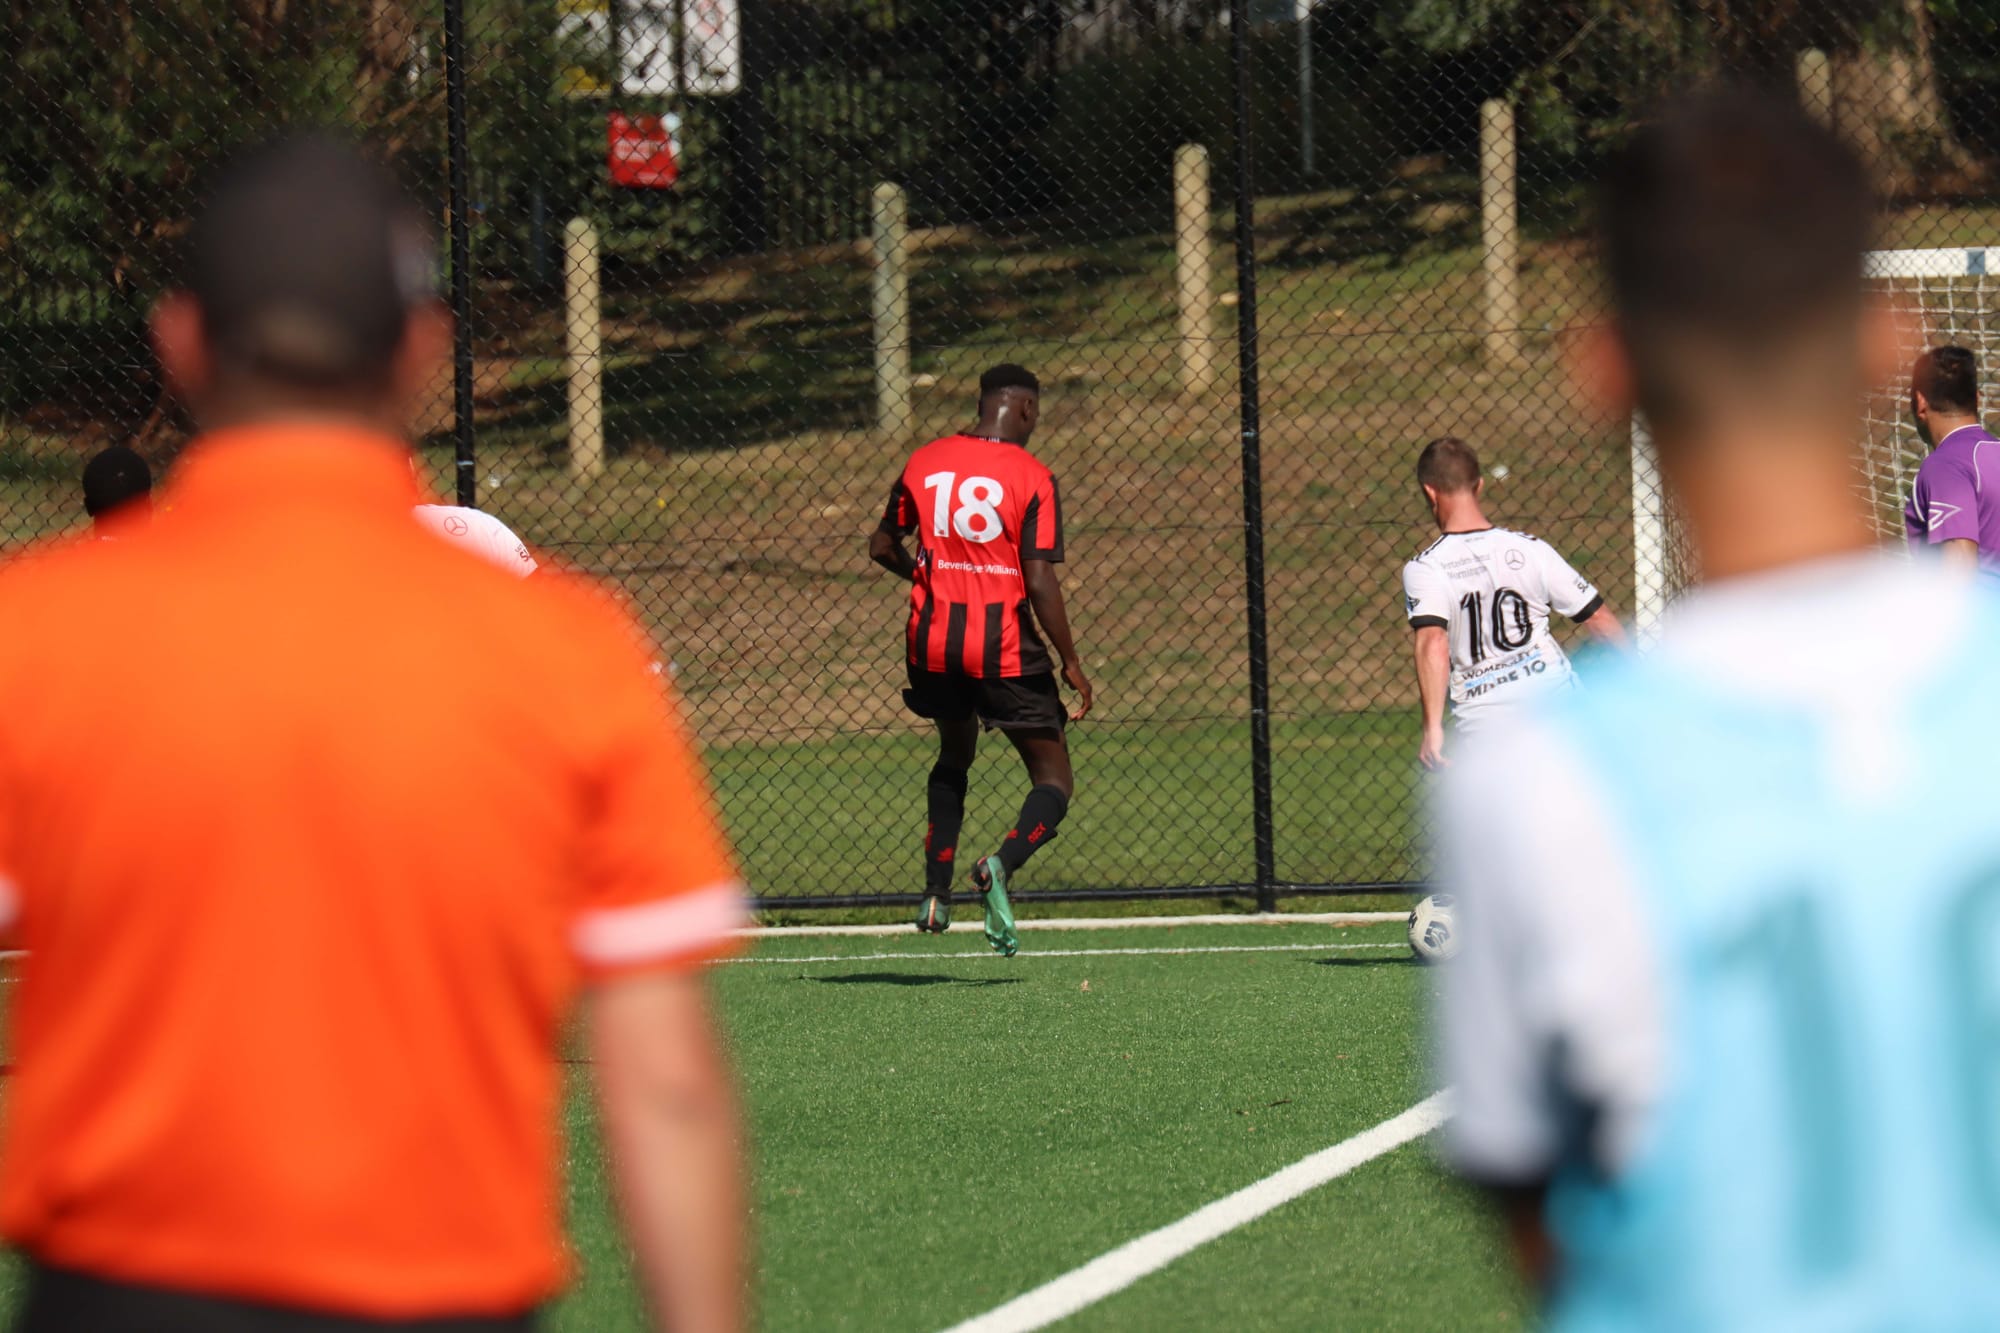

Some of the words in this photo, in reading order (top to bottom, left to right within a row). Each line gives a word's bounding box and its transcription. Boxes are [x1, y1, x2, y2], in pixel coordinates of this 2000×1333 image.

[924, 471, 1004, 544] 18
[1460, 586, 1533, 665] 10
[1523, 660, 1546, 677] 10
